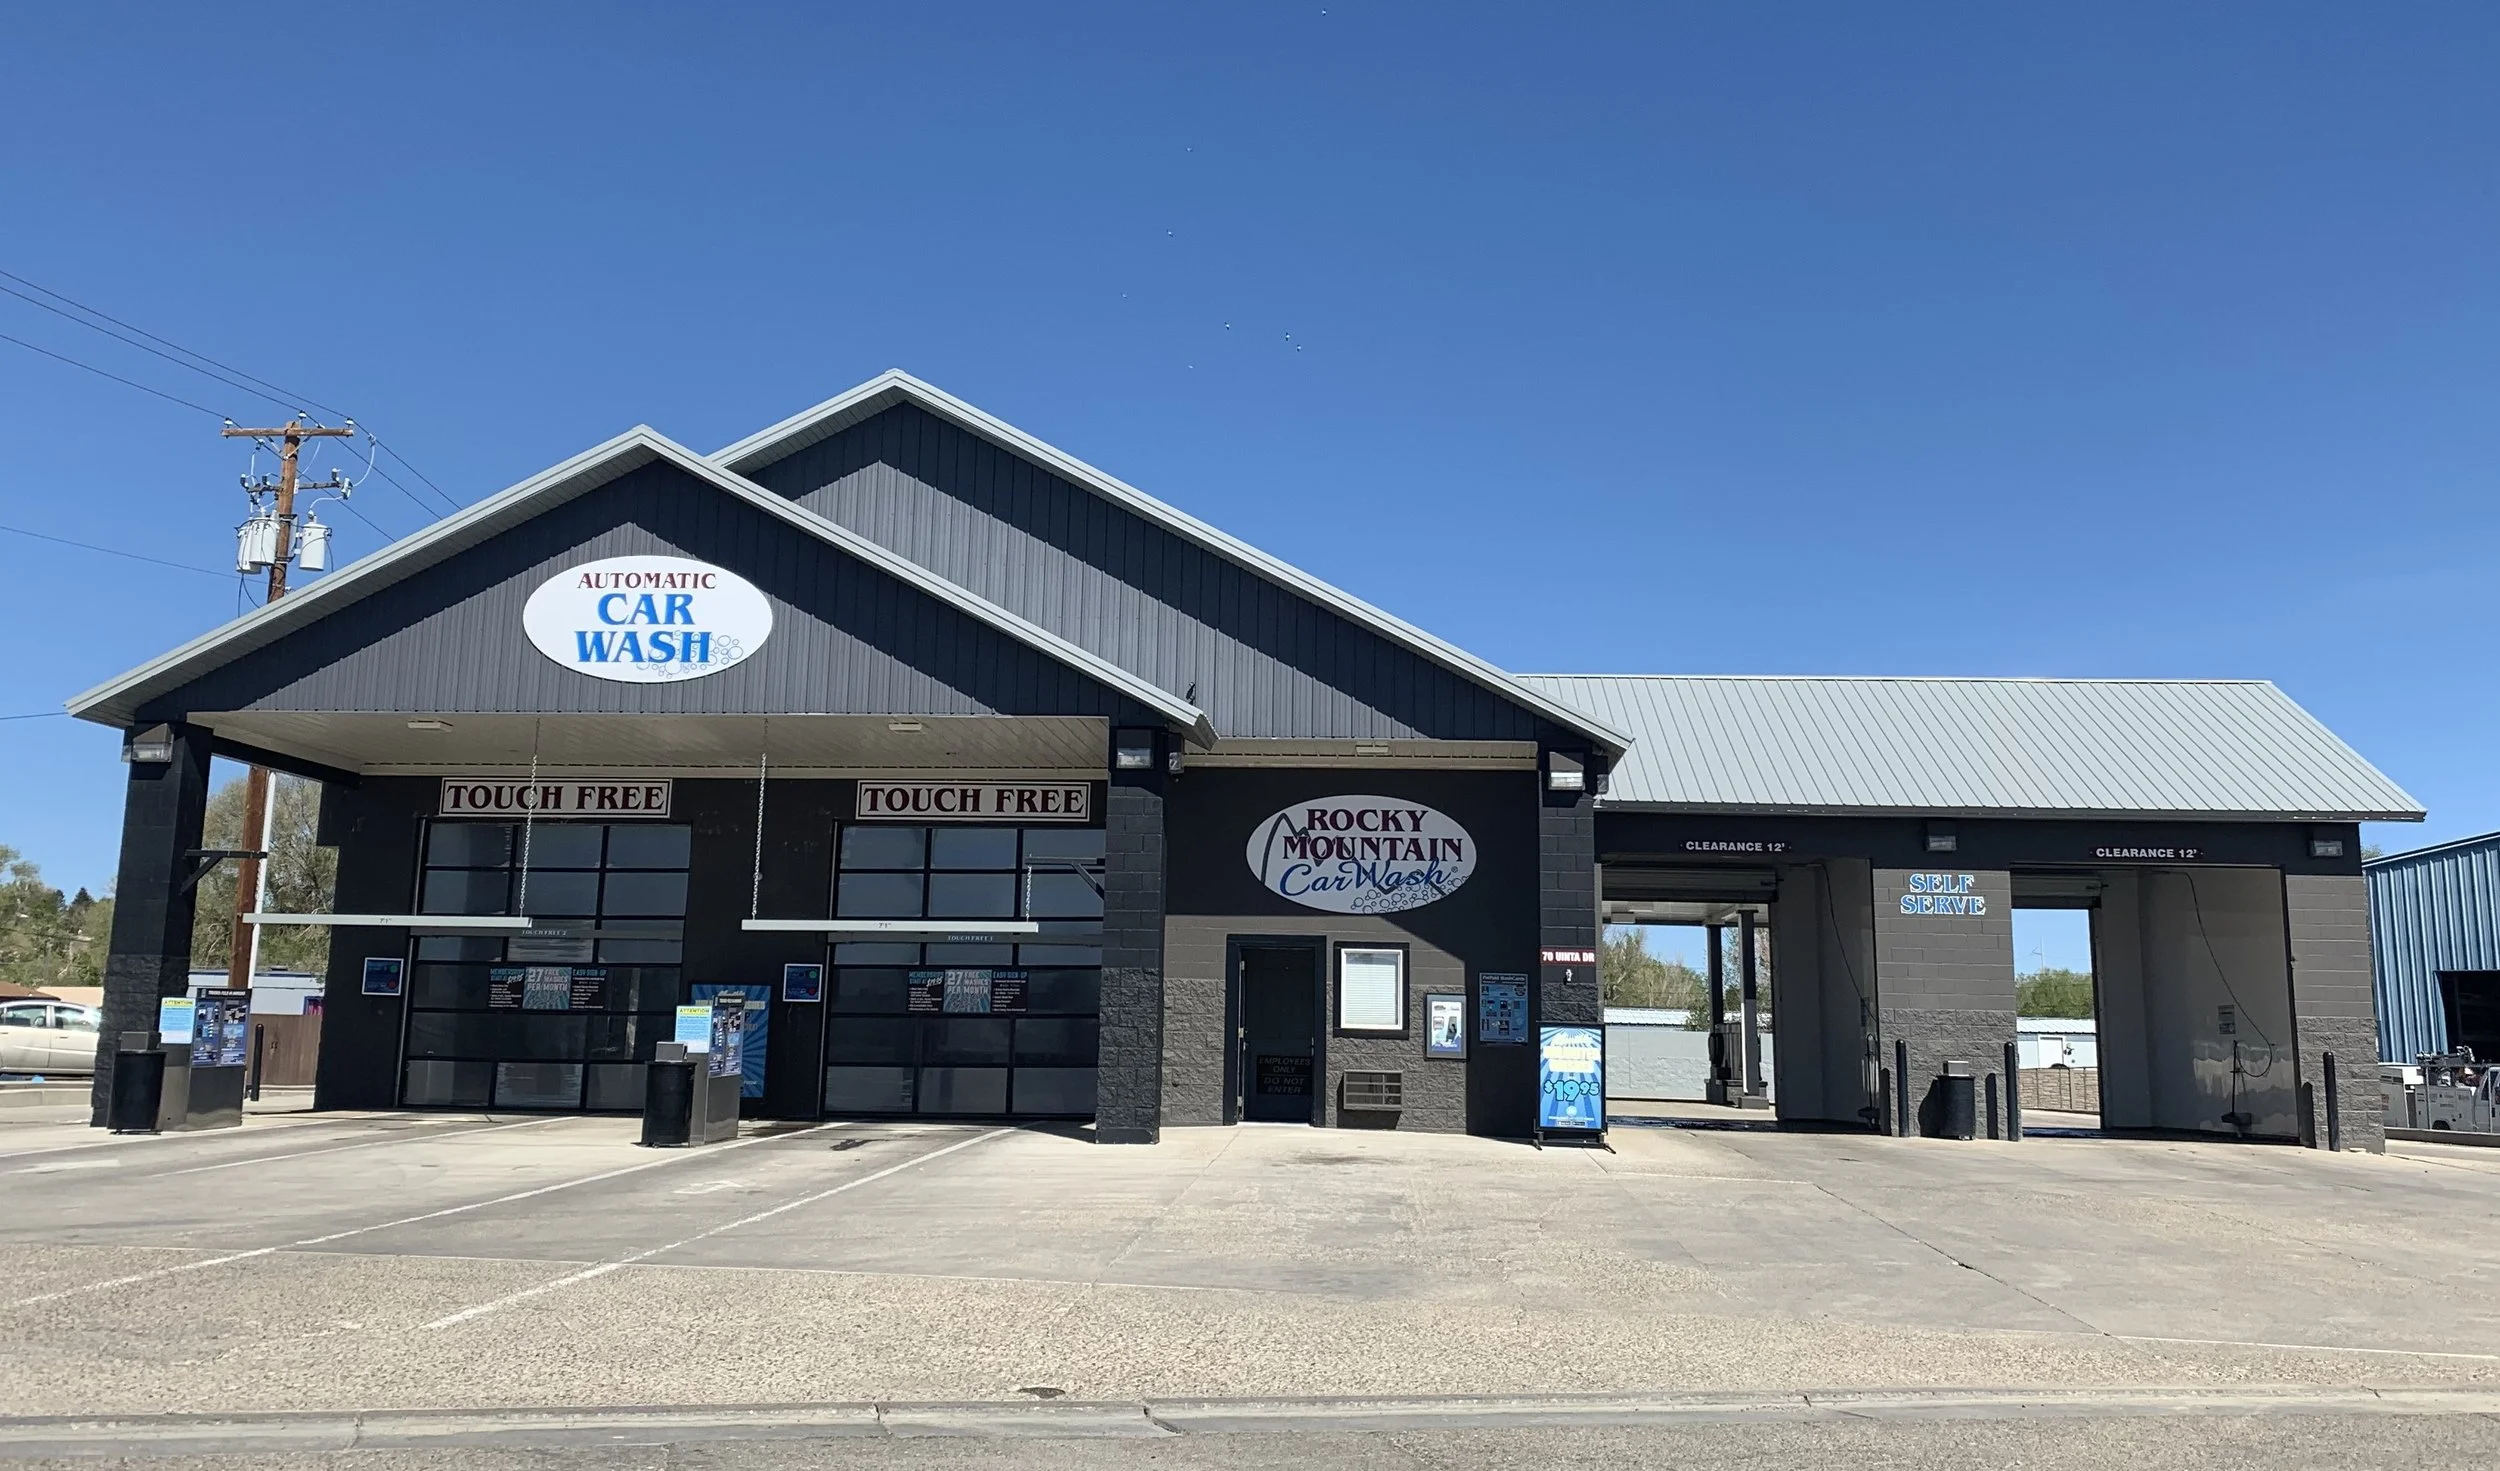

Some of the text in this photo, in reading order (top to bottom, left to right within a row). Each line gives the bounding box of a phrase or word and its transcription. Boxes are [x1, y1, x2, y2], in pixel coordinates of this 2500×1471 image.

[577, 572, 716, 589] AUTOMATIC
[597, 593, 695, 625] CAR
[574, 631, 712, 663] WASH
[446, 785, 665, 810] TOUCH FREE
[863, 788, 1084, 813] TOUCH FREE
[1306, 809, 1429, 832] ROCKY
[1282, 835, 1463, 862] MOUNTAIN
[1685, 841, 1785, 852] CLEARANCE 12'
[2096, 848, 2197, 858] CLEARANCE 12'
[1909, 873, 1975, 893] SELF
[1900, 894, 1987, 915] SERVE
[1582, 952, 1595, 962] DR
[527, 969, 543, 982] 27
[947, 972, 963, 985] 27
[527, 983, 568, 991] PER MONTH
[947, 986, 988, 994] PER MONTH
[1259, 1057, 1311, 1066] EMPLOYEES
[1273, 1065, 1296, 1073] ONLY
[1283, 1077, 1304, 1085] NOT
[1268, 1085, 1301, 1094] ENTER
